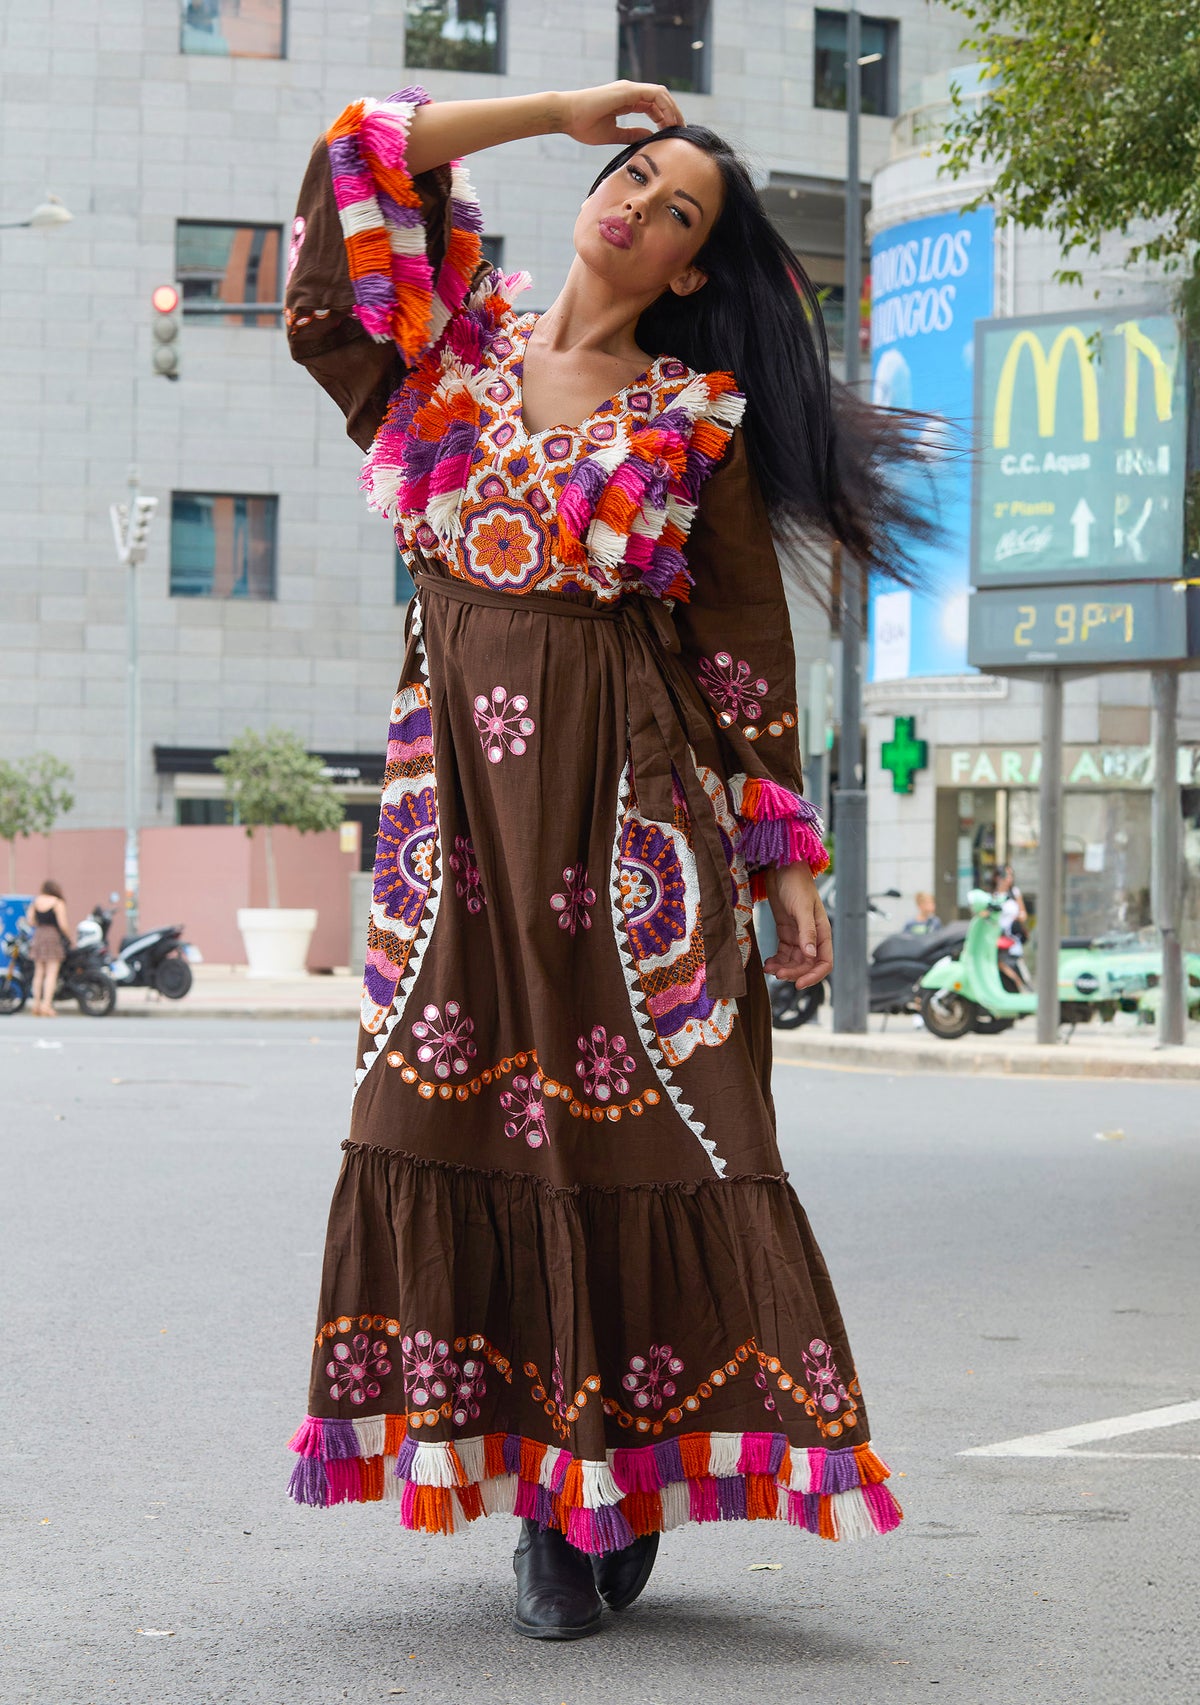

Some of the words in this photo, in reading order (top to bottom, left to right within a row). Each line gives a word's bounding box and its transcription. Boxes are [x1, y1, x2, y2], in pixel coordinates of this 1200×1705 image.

[918, 229, 972, 283] LOS
[1001, 453, 1041, 475] C.C.
[1043, 452, 1090, 475] Aqua
